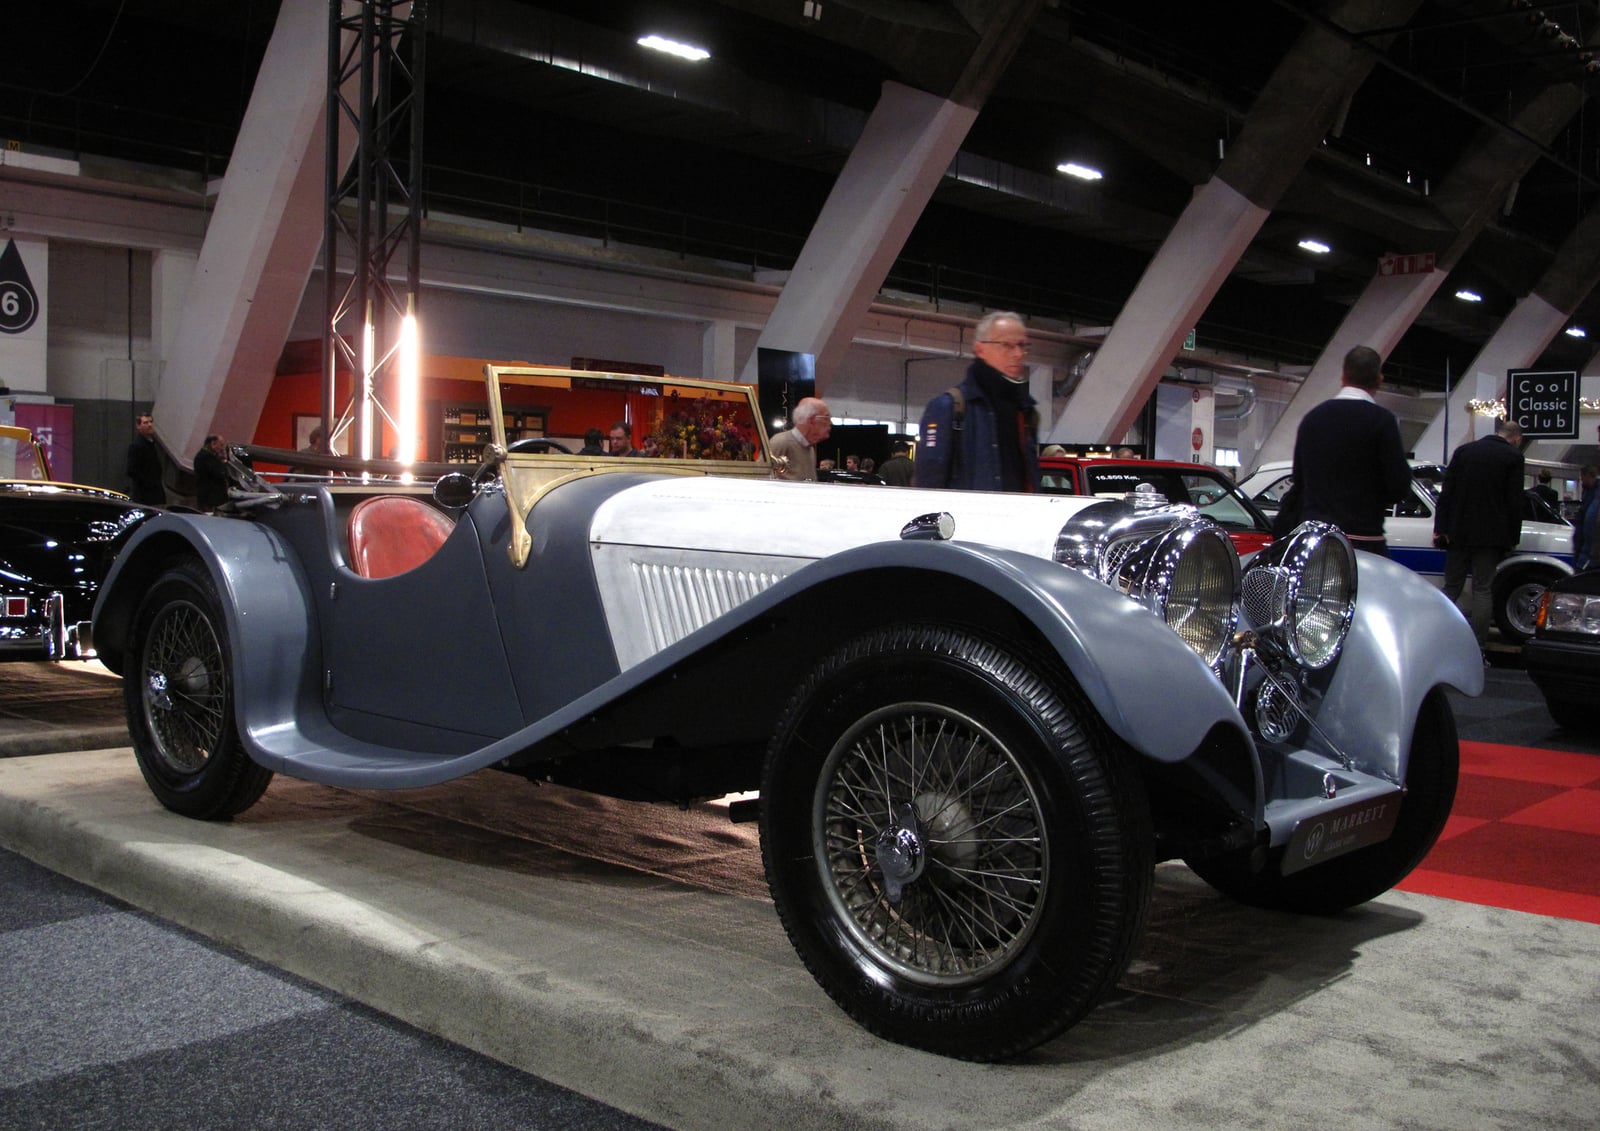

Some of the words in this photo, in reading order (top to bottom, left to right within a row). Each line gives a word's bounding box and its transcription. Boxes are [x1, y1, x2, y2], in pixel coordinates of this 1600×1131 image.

[2, 291, 19, 316] 6
[1519, 379, 1568, 393] Cool
[1519, 397, 1567, 411] Classic
[1518, 414, 1566, 428] Club
